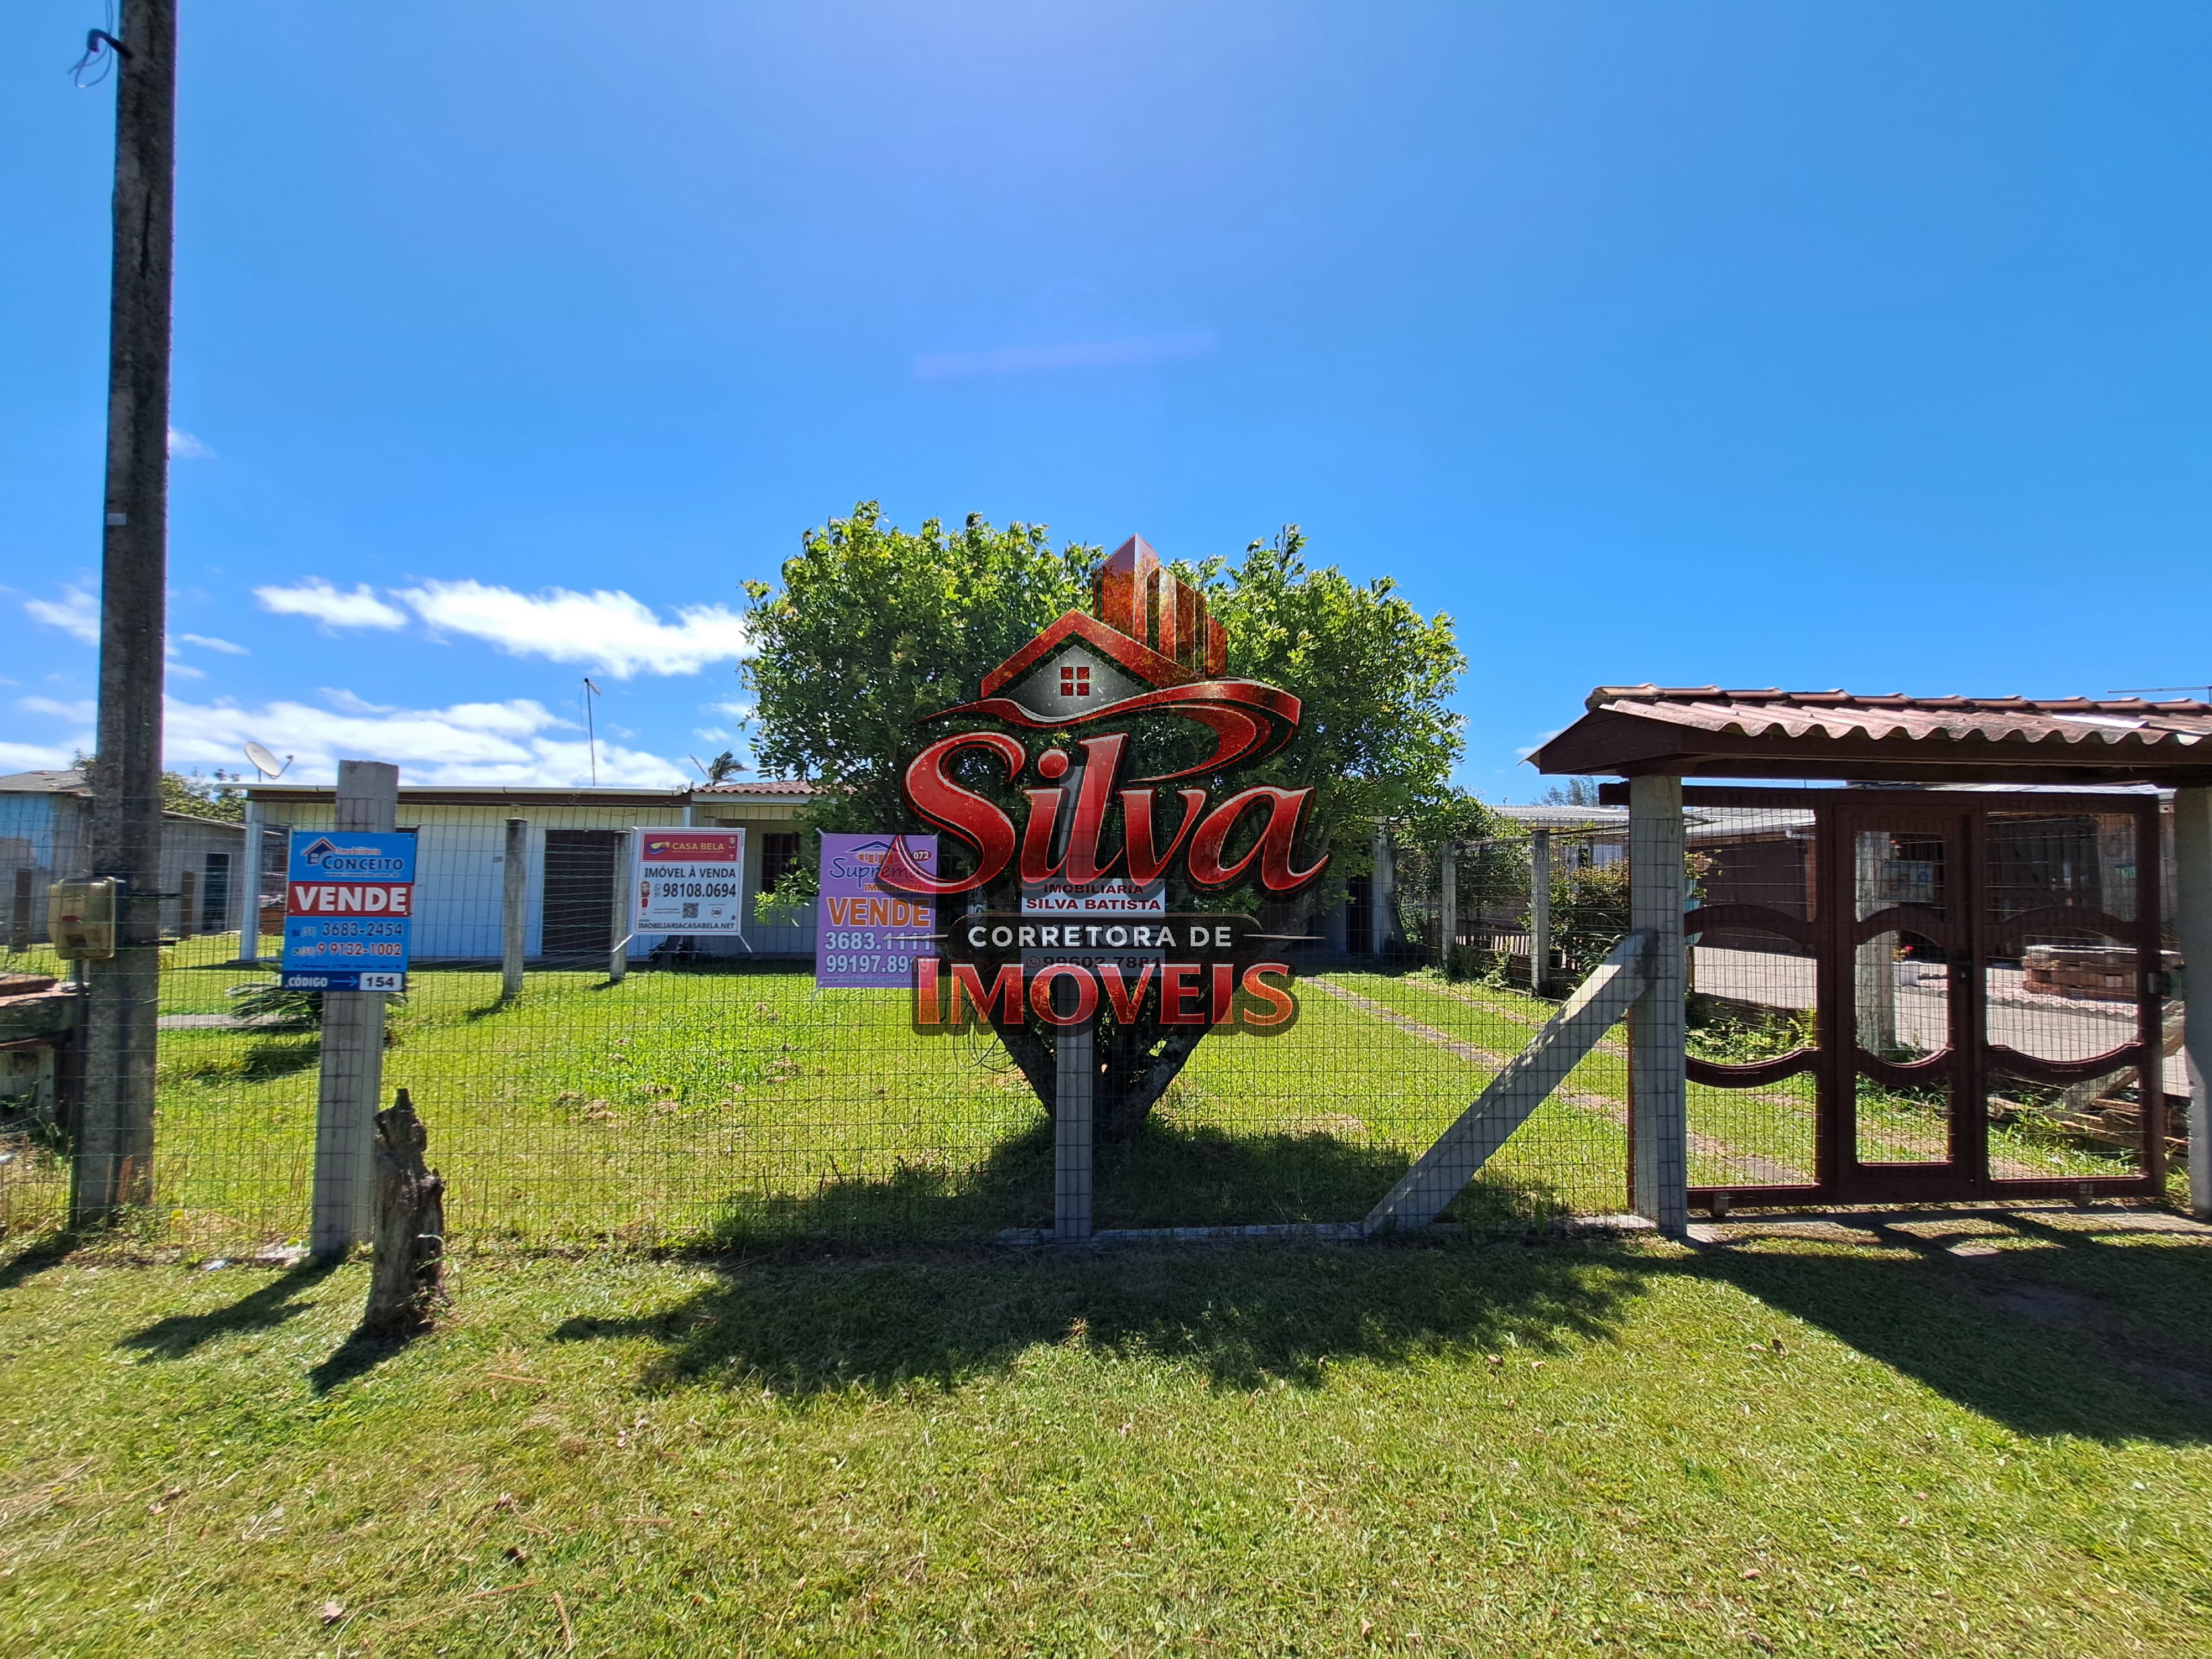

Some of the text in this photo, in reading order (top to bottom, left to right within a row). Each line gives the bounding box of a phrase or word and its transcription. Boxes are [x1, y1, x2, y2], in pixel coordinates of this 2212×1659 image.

[322, 855, 403, 870] CONCEITO
[913, 851, 930, 860] 072
[645, 865, 736, 878] IMÓVEL À VENDA
[663, 883, 737, 898] 98108.0694
[295, 886, 407, 912] VENDE
[1026, 899, 1161, 910] SILVA BATISTA
[827, 897, 931, 927] VENDE
[322, 922, 403, 936] 3683-2454
[825, 931, 932, 951] 3683.1111
[318, 943, 325, 955] 9
[330, 943, 401, 956] 9132-1002
[288, 974, 394, 987] CÓDIGO 154
